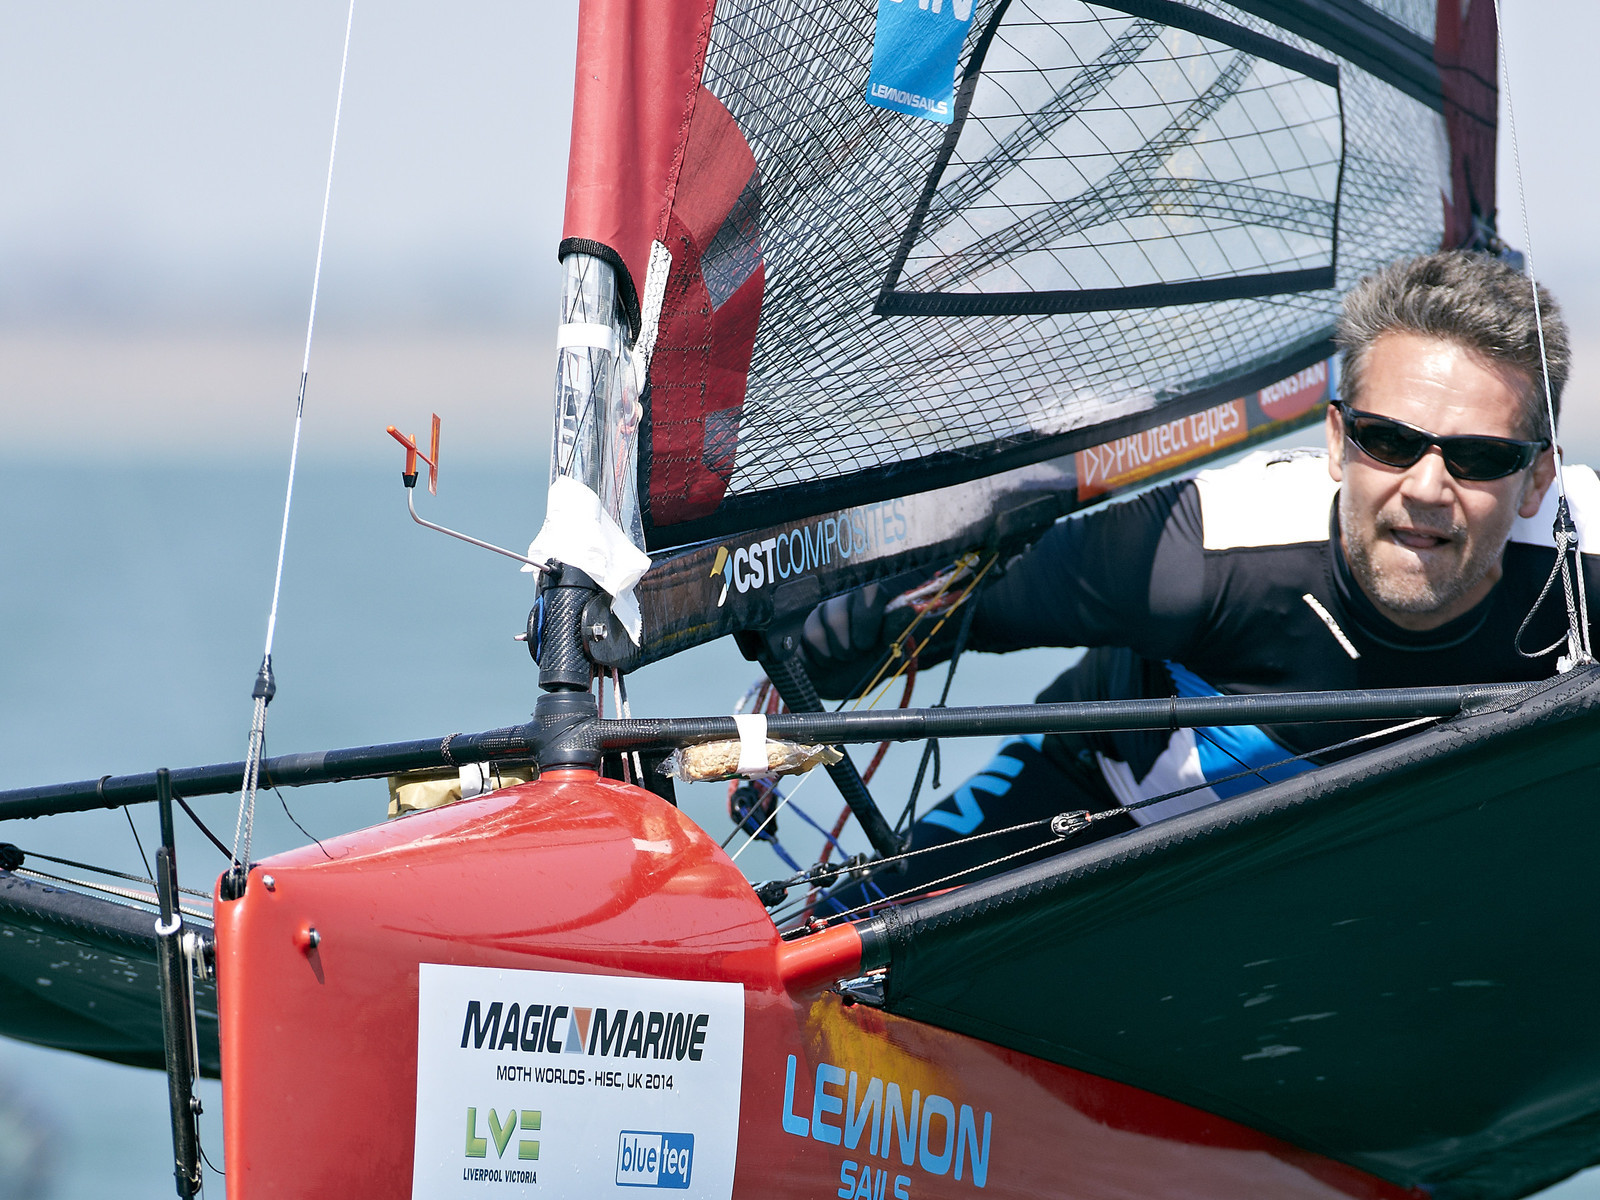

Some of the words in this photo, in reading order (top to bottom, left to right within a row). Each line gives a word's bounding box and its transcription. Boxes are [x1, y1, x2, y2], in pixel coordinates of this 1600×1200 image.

[1190, 400, 1240, 448] tapes
[460, 1000, 569, 1054] MAGIC
[588, 1007, 710, 1062] MARINE
[496, 1065, 532, 1082] MOTH
[534, 1066, 586, 1086] WORLDS
[594, 1070, 625, 1091] HISC,
[626, 1073, 643, 1089] UK
[645, 1073, 674, 1090] 2014
[782, 1053, 993, 1189] LENNON
[463, 1167, 503, 1183] LIVERPOOL
[504, 1169, 538, 1184] VICTORIA
